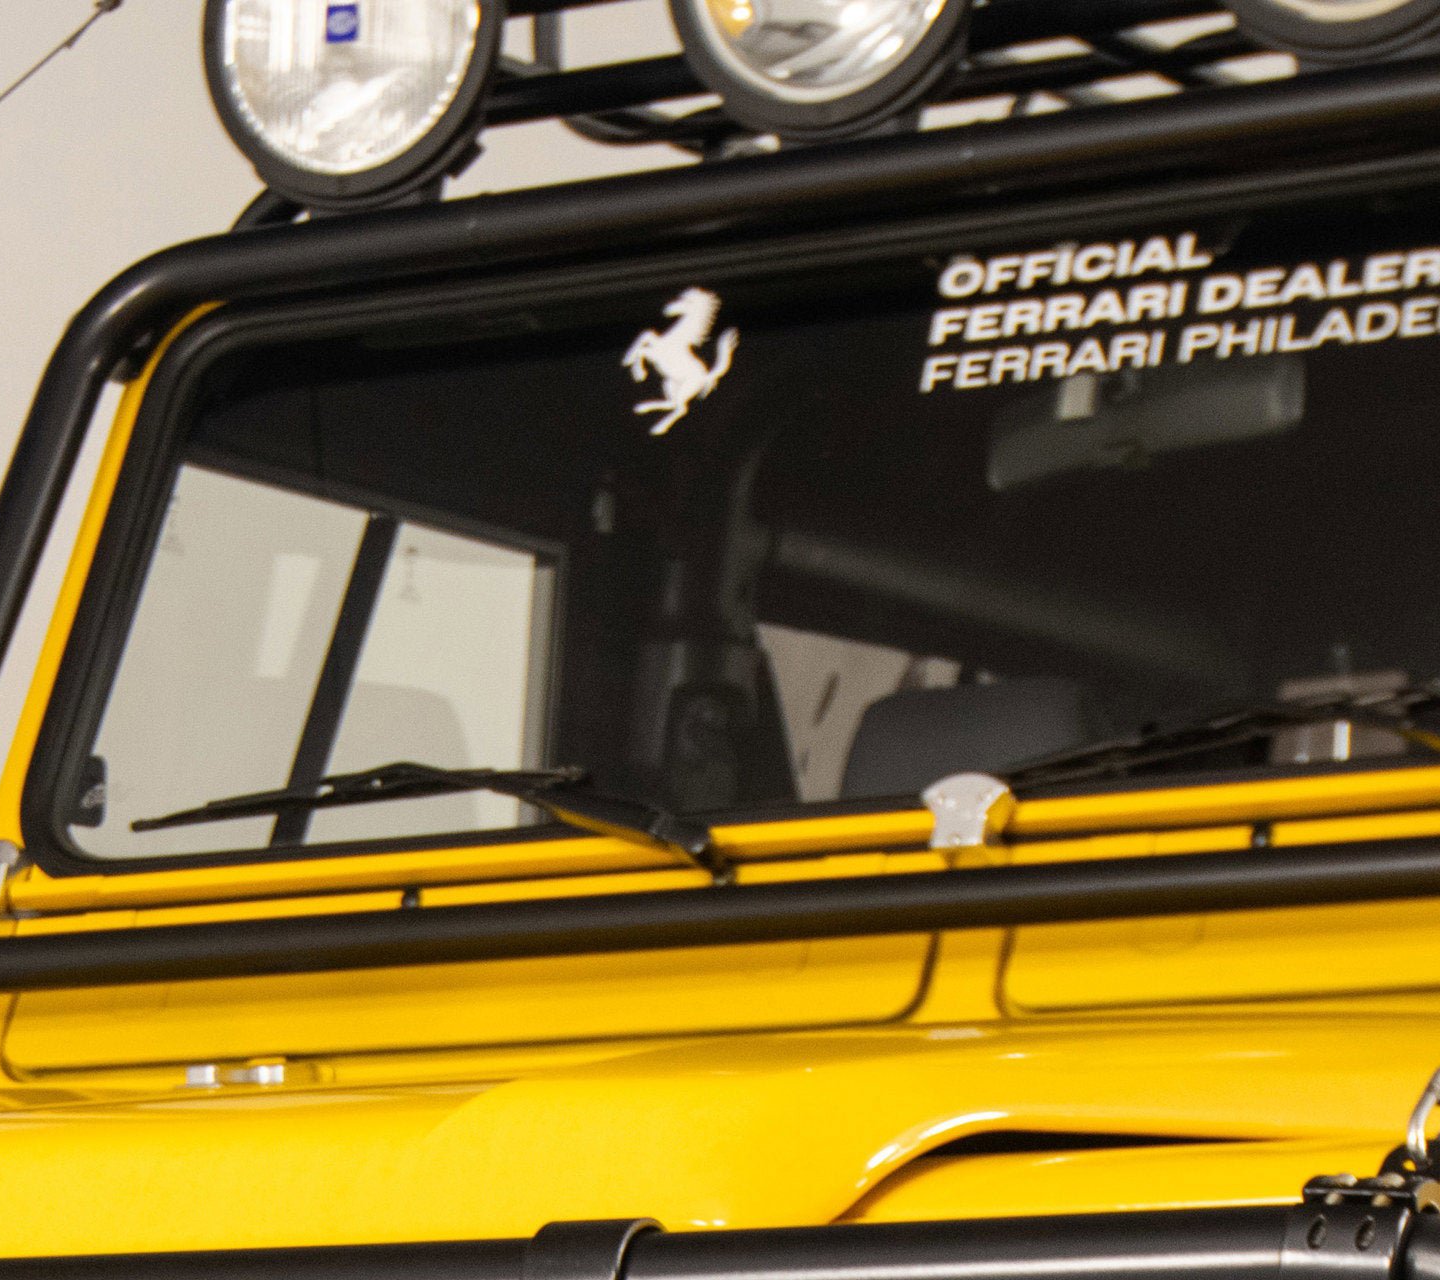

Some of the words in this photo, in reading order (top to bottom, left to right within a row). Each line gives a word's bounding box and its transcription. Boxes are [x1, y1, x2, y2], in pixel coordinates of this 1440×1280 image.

[937, 231, 1213, 299] OFFICIAL
[928, 281, 1189, 347] FERRARI
[919, 330, 1166, 394] FERRARI
